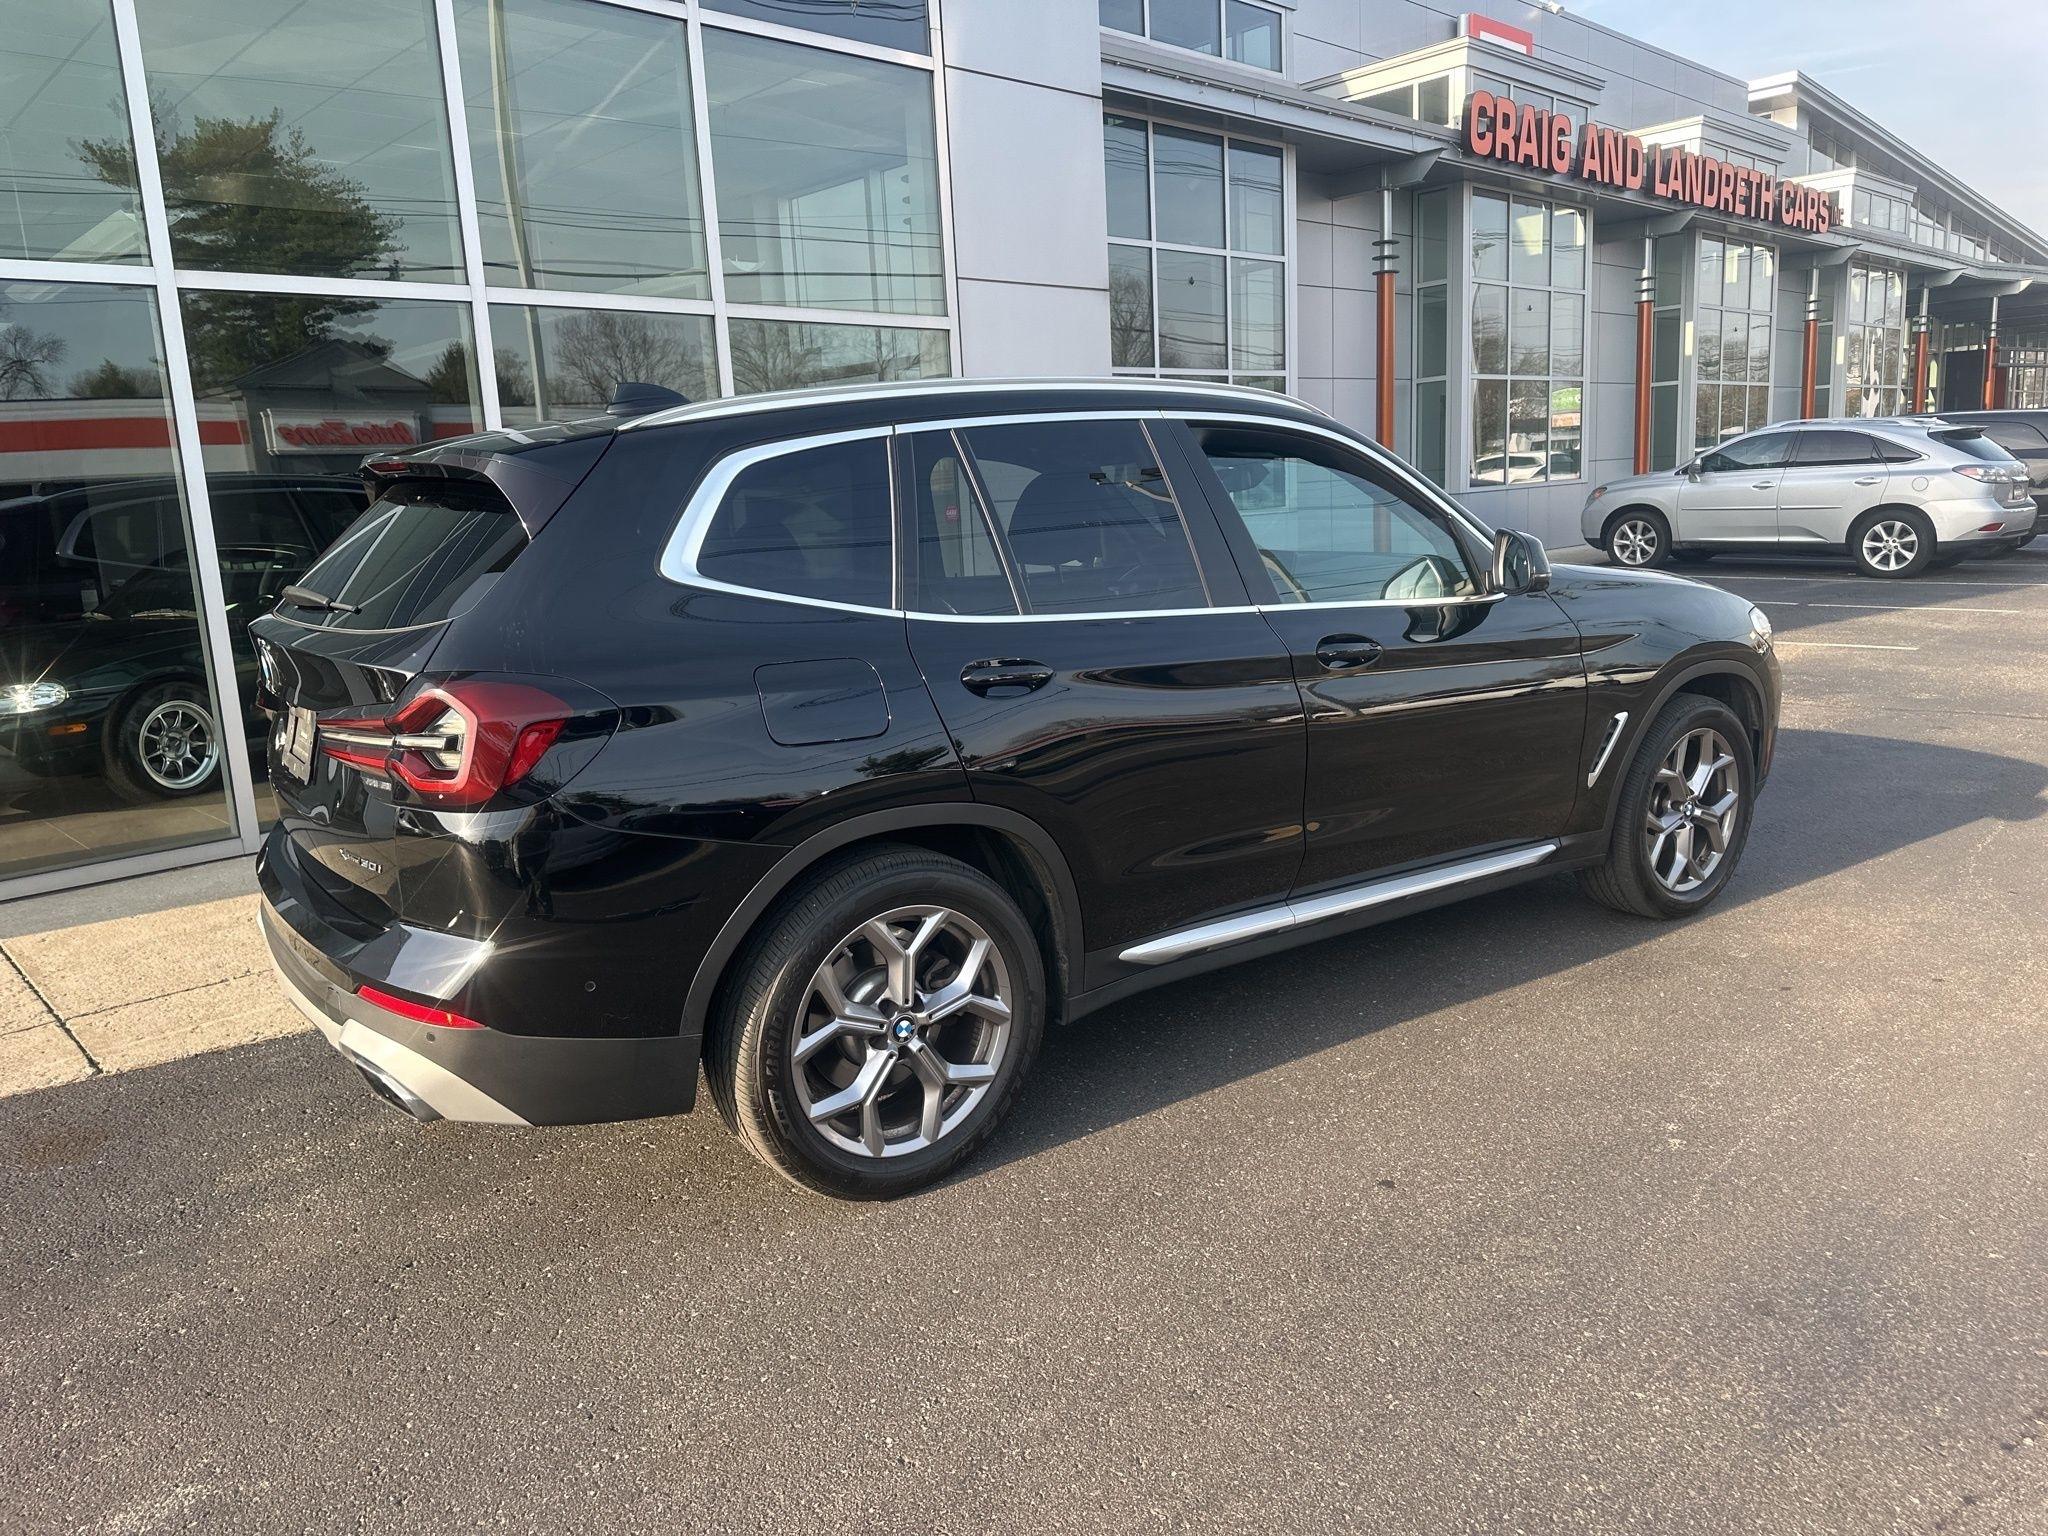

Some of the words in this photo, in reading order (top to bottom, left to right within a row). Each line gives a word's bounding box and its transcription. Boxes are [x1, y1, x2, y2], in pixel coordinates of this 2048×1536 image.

[1468, 89, 1573, 175] CRAIG
[1583, 123, 1643, 190] AND
[1654, 146, 1776, 222] LANDRETH
[1781, 181, 1830, 234] CARS
